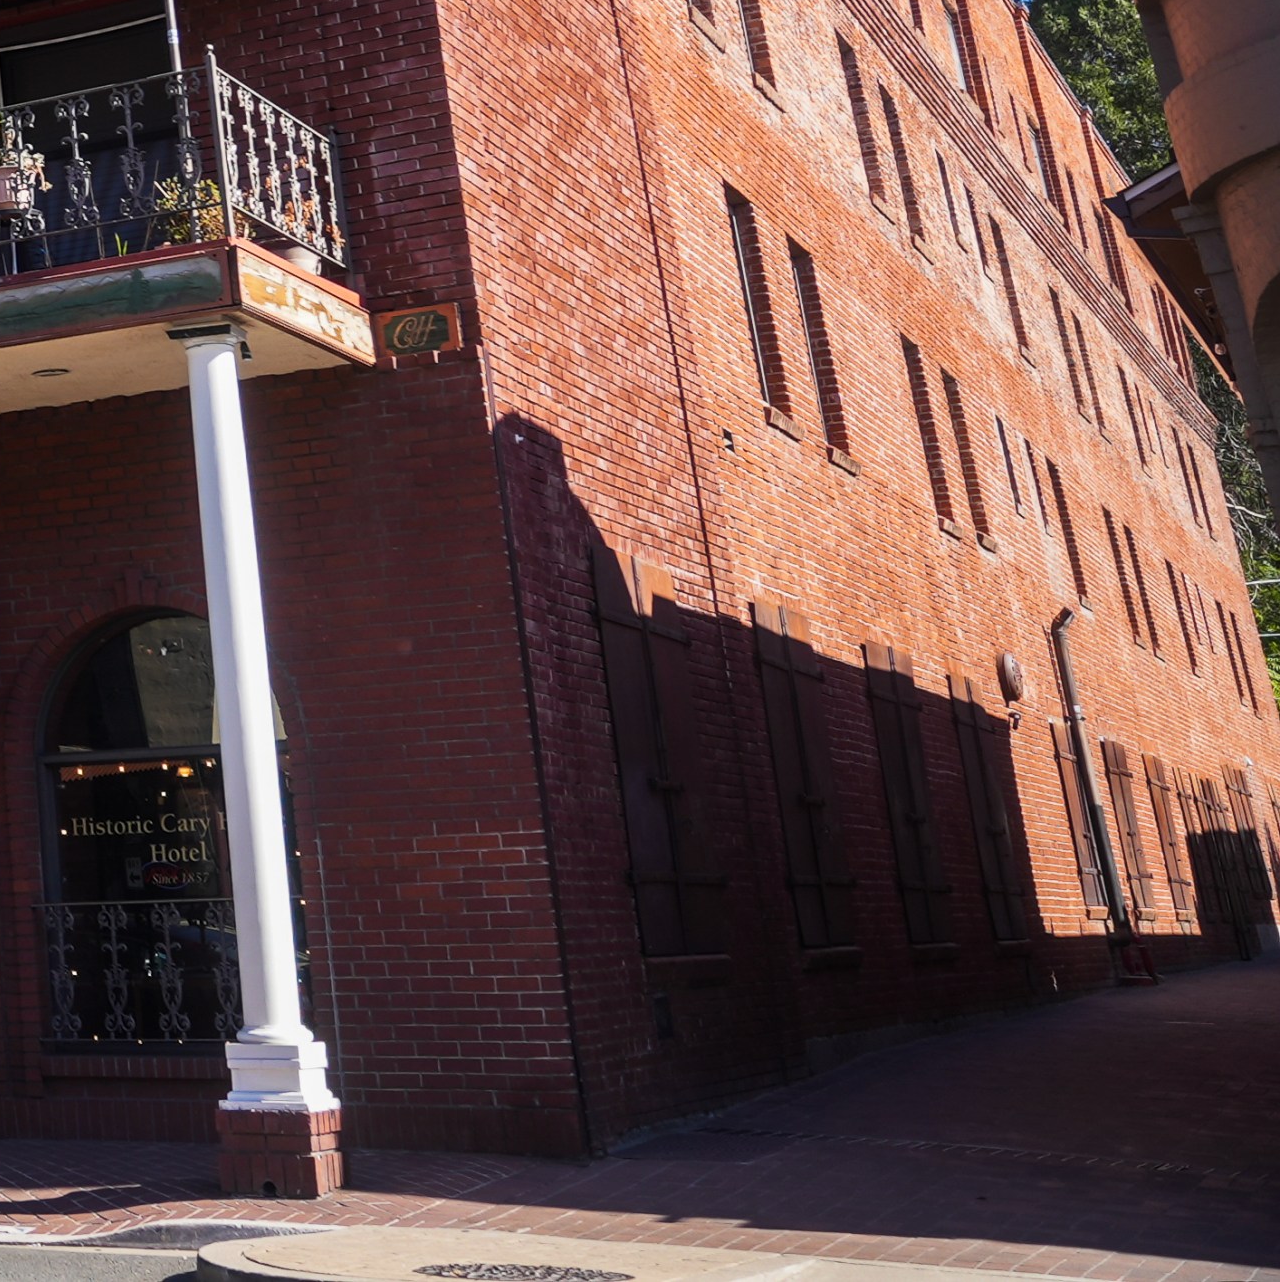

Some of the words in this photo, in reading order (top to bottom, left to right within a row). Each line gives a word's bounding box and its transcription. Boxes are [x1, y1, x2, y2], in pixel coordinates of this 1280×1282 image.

[71, 815, 154, 836] Historic
[160, 813, 210, 838] Cary
[149, 841, 209, 863] Hotel
